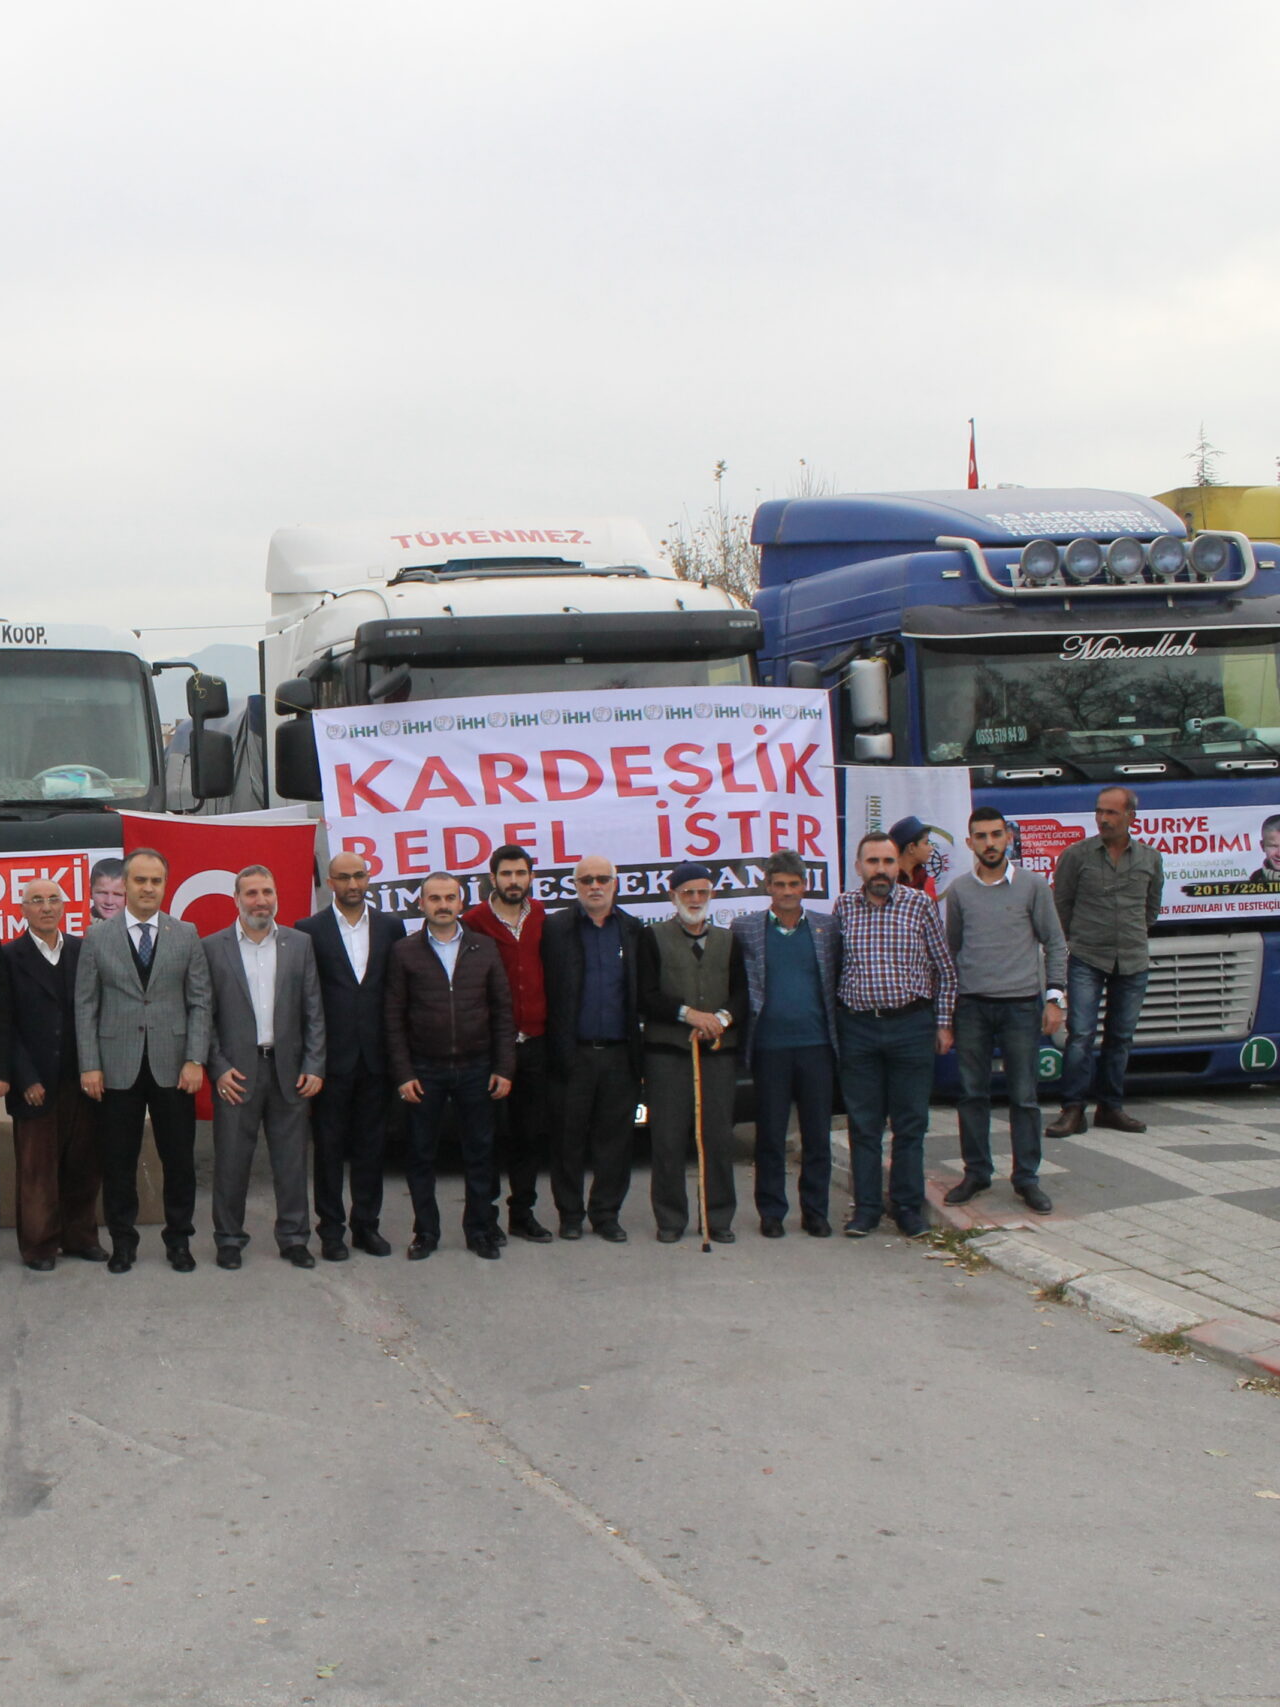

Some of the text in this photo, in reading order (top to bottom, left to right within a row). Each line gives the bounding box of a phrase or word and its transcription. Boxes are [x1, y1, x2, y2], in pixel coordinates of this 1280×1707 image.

[390, 530, 592, 549] TÜKENMEZ
[2, 625, 48, 645] KOOP.
[335, 724, 825, 818] KARDEŞLİK
[342, 819, 584, 878] BEDEL
[1179, 868, 1208, 880] ÖLÜM
[1209, 868, 1248, 878] KAPIDA
[1172, 901, 1223, 914] MEZUNLARI
[1224, 902, 1236, 911] VE
[1250, 1044, 1267, 1068] L
